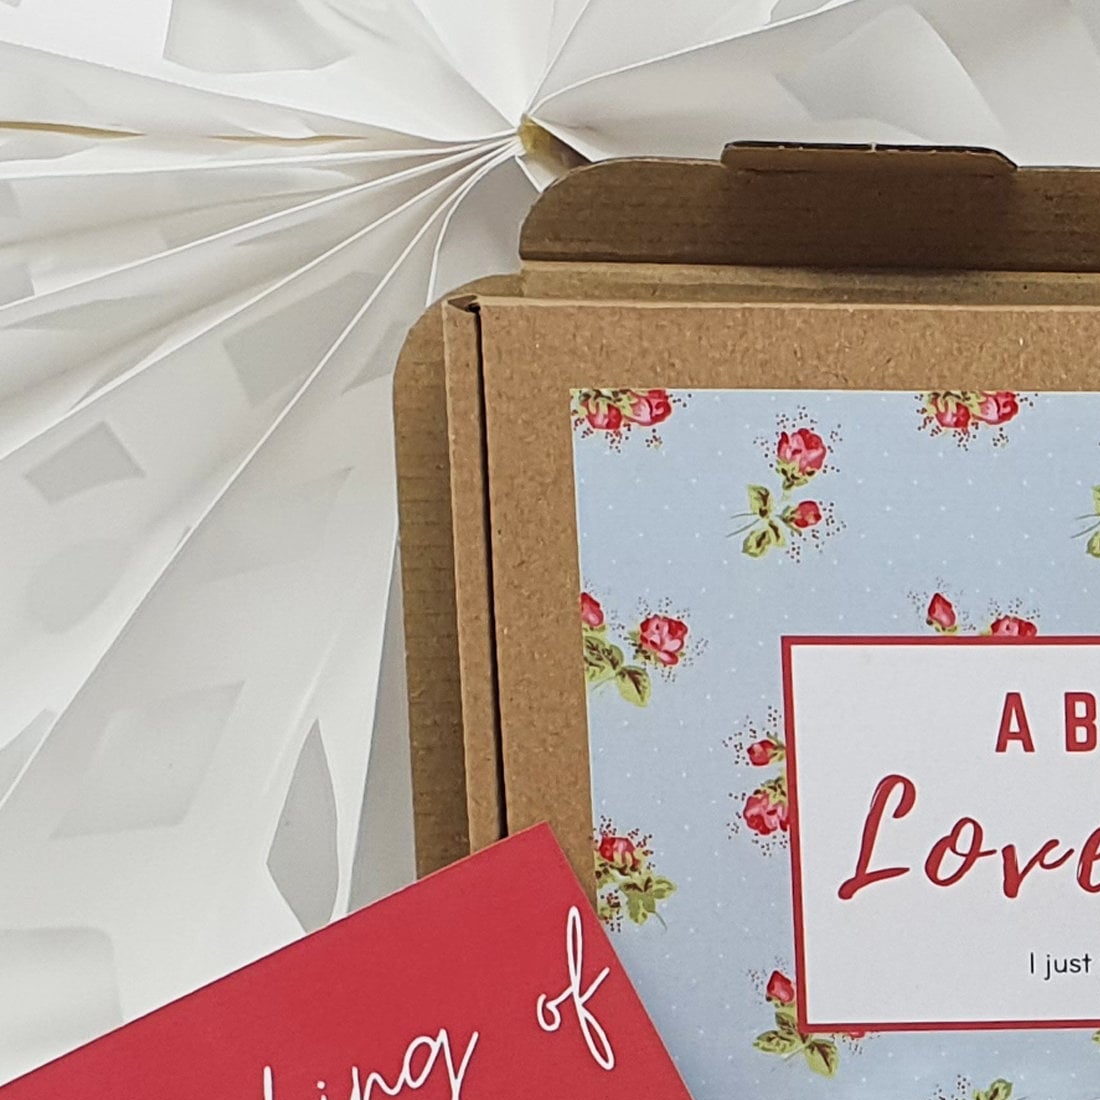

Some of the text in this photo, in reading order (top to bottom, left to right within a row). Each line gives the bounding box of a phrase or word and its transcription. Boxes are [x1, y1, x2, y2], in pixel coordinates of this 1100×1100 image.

[994, 691, 1035, 753] A
[536, 905, 616, 1071] of
[1029, 951, 1036, 975] I
[1043, 951, 1092, 980] just
